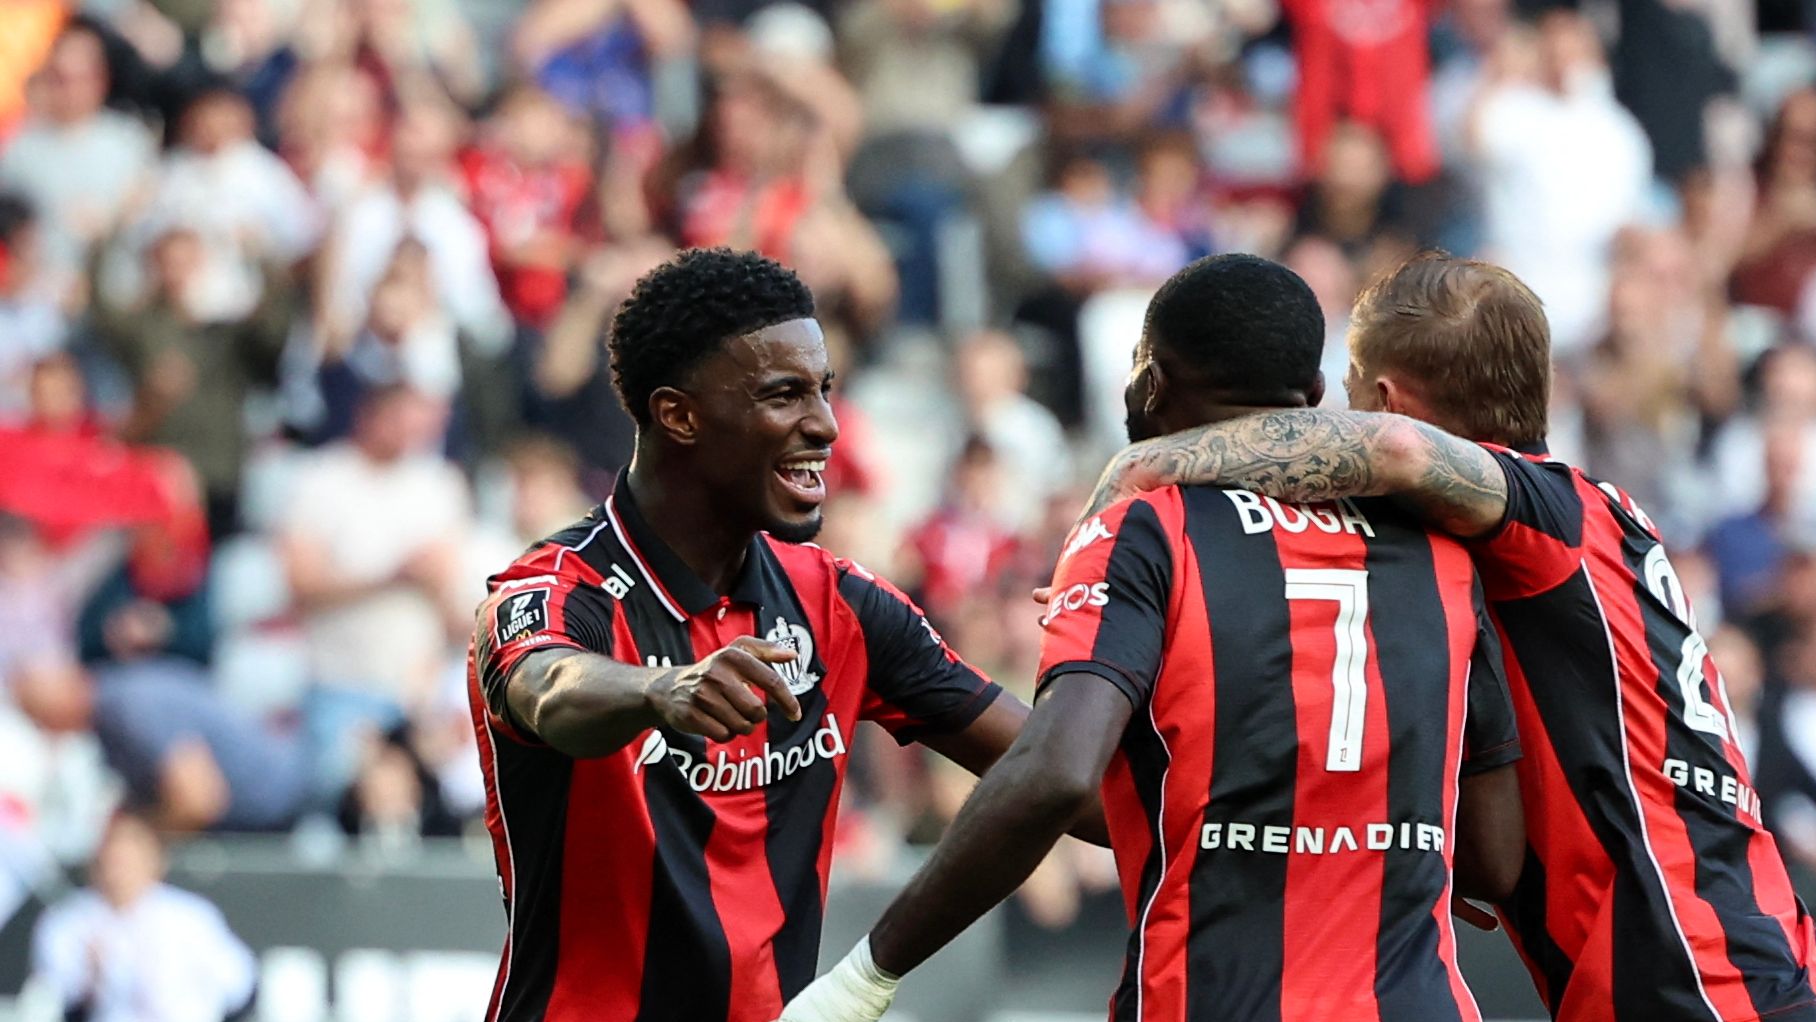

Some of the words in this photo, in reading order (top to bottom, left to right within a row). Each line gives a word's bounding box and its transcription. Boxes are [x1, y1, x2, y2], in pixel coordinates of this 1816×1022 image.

[1222, 489, 1376, 538] BOGA
[1285, 568, 1369, 772] 7
[667, 713, 847, 792] Robinhood
[1200, 822, 1446, 855] GRENADIER
